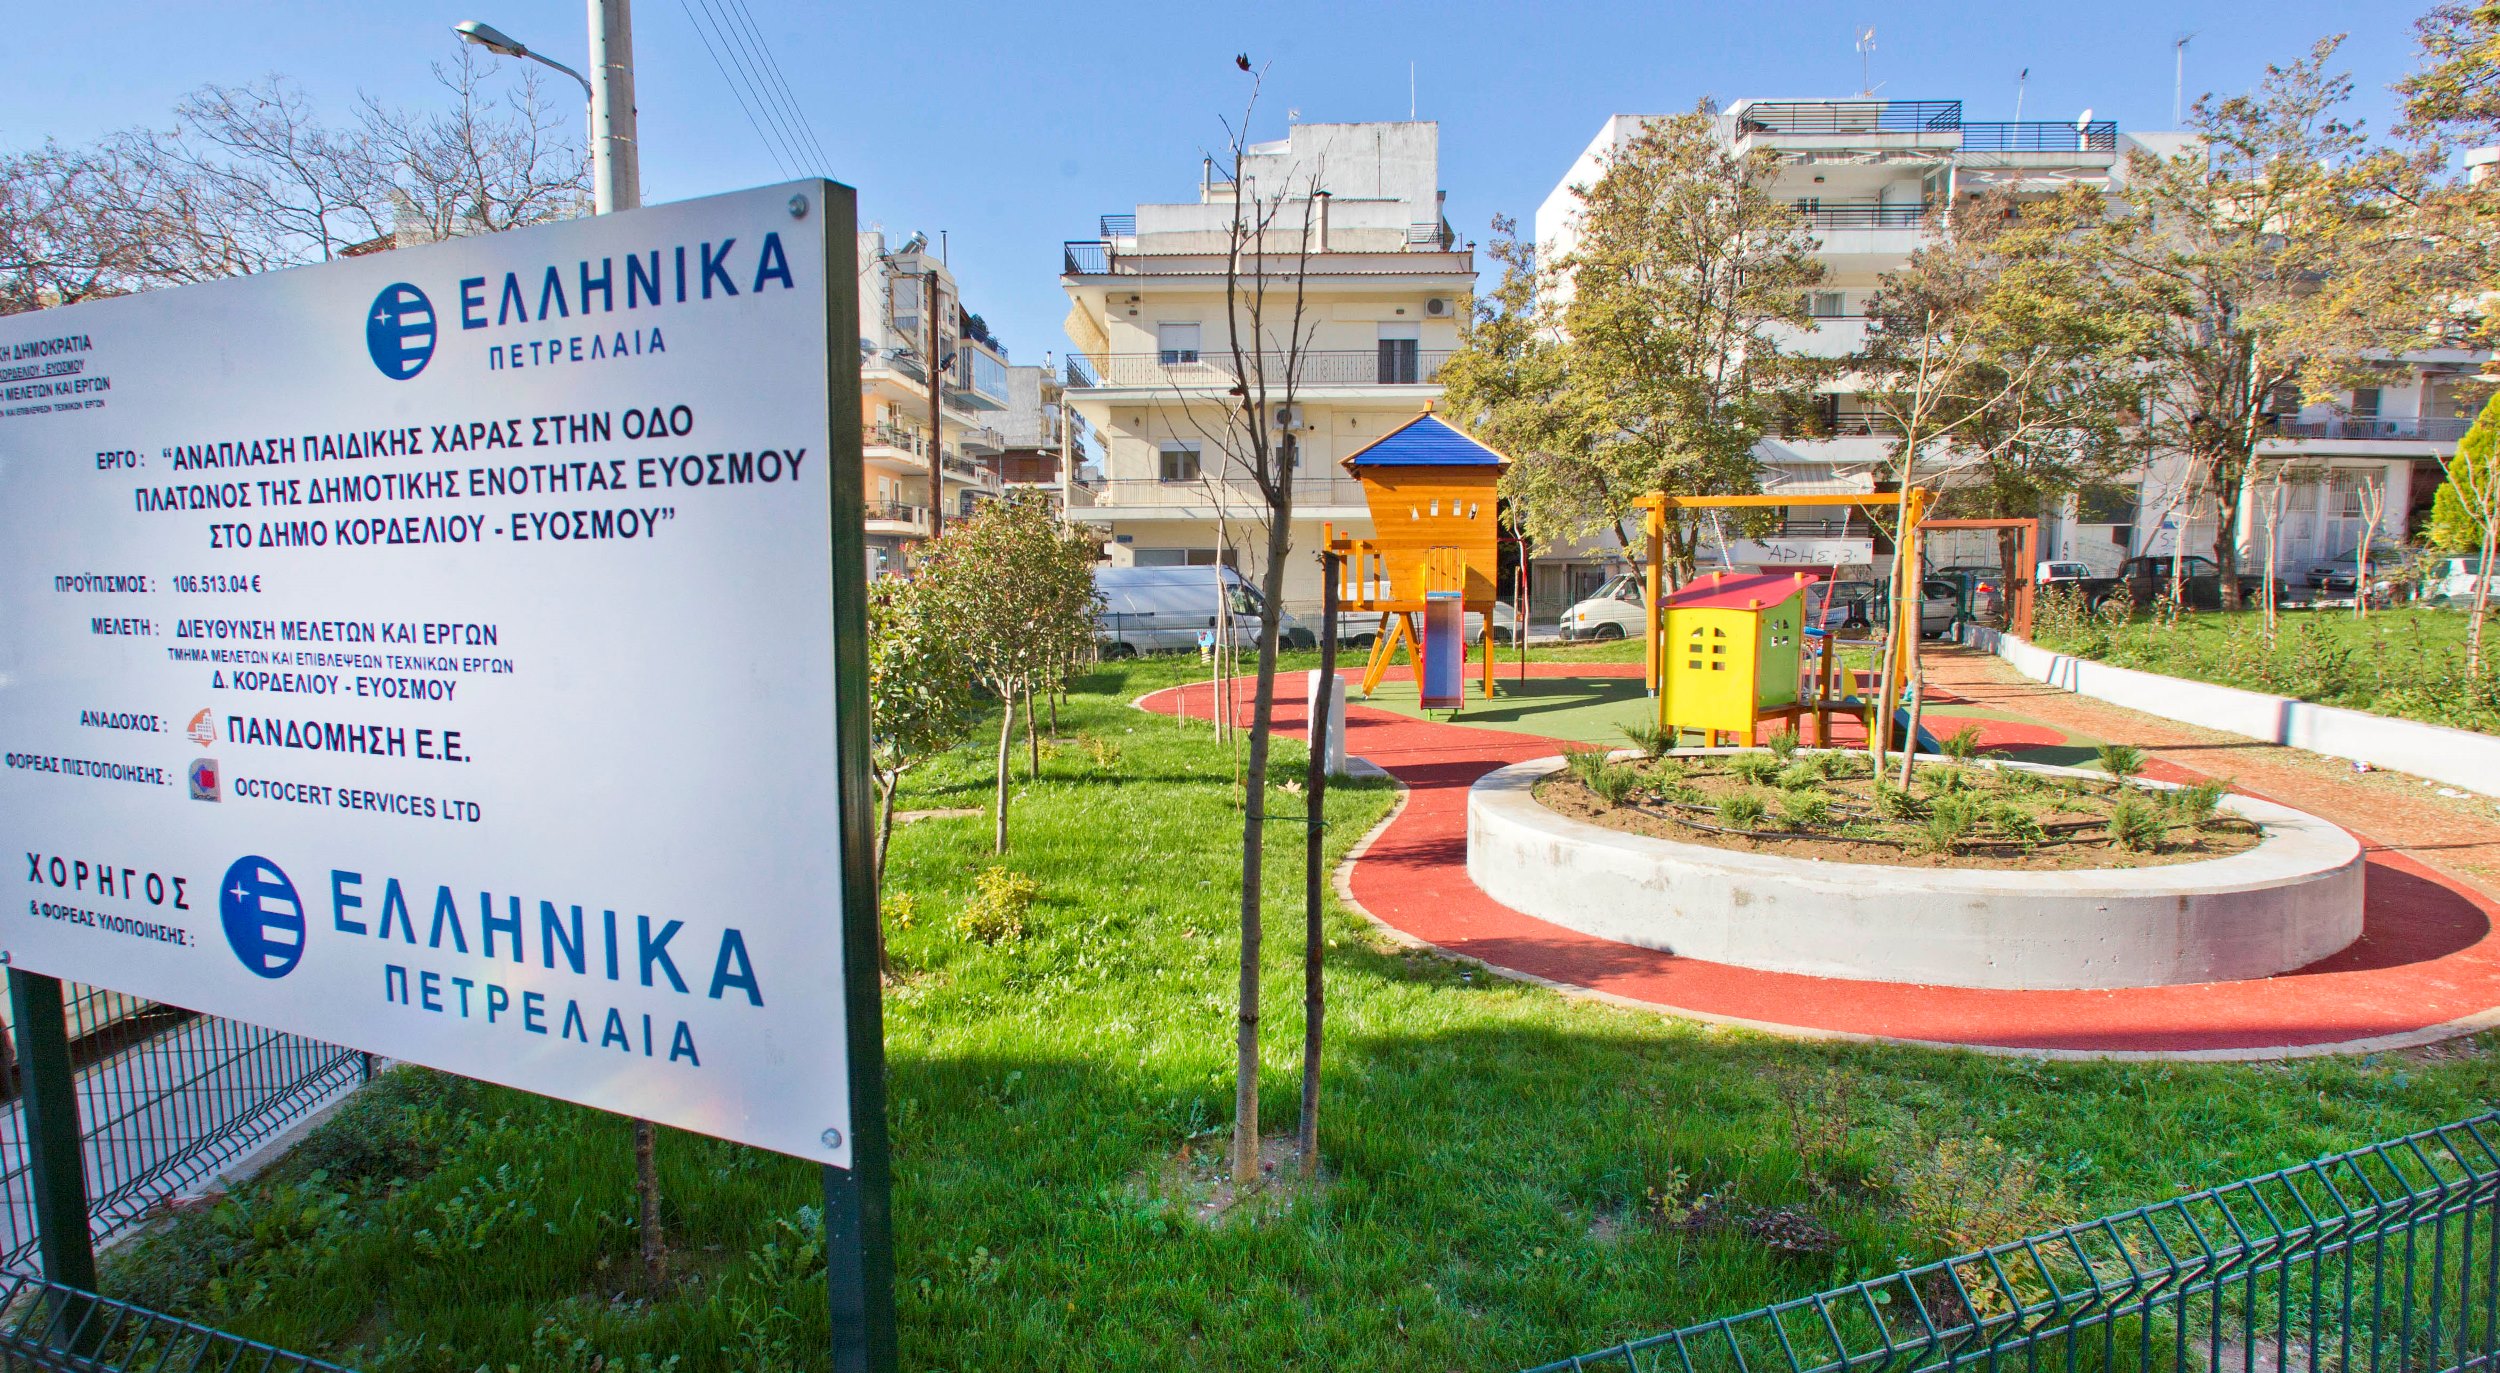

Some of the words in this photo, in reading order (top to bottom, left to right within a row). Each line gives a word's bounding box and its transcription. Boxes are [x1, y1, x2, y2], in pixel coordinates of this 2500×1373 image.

[460, 232, 794, 330] ΕΛΛΗΝΙΚΑ
[14, 335, 93, 361] ΔΗΜΟΚΡΑΤΙΑ
[490, 328, 665, 370] ΠΕΤΡΕΛΑΙΑ
[45, 359, 85, 375] ΕΥΟΣΜΟΥ
[6, 383, 53, 401] ΜΕΛΕΤΩΝ
[55, 381, 73, 396] ΚΑΙ
[75, 376, 111, 394] ΕΡΓΩΝ
[84, 399, 105, 409] ΕΡΓΩΝ
[96, 450, 136, 469] ΕΡΓΟ
[303, 428, 423, 462] ΠΑΙΔΙΚΗΣ
[431, 419, 523, 453] ΧΑΡΑΣ
[532, 411, 611, 446] ΣΤΗΝ
[622, 405, 693, 440] ΟΔΟ
[136, 482, 251, 512] ΠΛΑΤΩΝΟΣ
[257, 480, 302, 506] ΤΗΣ
[308, 470, 460, 504] ΔΗΜΟΤΙΚΗΣ
[469, 460, 627, 496] ΕΝΟΤΗΤΑΣ
[638, 448, 806, 488] ΕΥΟΣΜΟΥ
[210, 523, 252, 548] ΣΤΟ
[258, 520, 327, 547] ΔΗΜΟ
[335, 515, 485, 545] ΚΟΡΔΕΛΙΟΥ
[1768, 544, 1830, 563] ΑΡΗΣ
[92, 618, 151, 635] ΜΕΛΕΤΗ
[177, 619, 275, 640] ΔΙΕΥΘΥΝΣΗ
[281, 621, 375, 642] ΜΕΛΕΤΩΝ
[382, 623, 416, 643] ΚΑΙ
[423, 623, 497, 645] ΕΡΓΩΝ
[168, 648, 209, 661] ΤΜΗΜΑ
[211, 649, 268, 664] ΜΕΛΕΤΩΝ
[272, 652, 292, 665] ΚΑΙ
[296, 652, 382, 668] ΕΠΙΒΛΕΨΕΩΝ
[386, 655, 458, 671] ΤΕΧΝΙΚΩΝ
[463, 658, 513, 673] ΕΡΓΩΝ
[212, 670, 229, 689] Δ.
[233, 671, 338, 694] ΚΟΡΔΕΛΙΟΥ
[356, 676, 456, 701] ΕΥΟΣΜΟΥ
[81, 711, 160, 732] ΑΝΑΔΟΧΟΣ
[228, 716, 405, 757] ΠΑΝΔΟΜΗΣΗ
[416, 729, 470, 762] Ε.Ε.
[6, 753, 59, 773] ΦΟΡΕΑΣ
[62, 758, 164, 785] ΠΙΣΤΟΠΟΙΗΣΗΣ
[235, 778, 332, 805] OCTOCERT
[338, 788, 436, 817] SERVICES
[443, 800, 480, 822] LTD
[27, 852, 189, 910] ΧΟΡΗΓΟΣ
[30, 900, 39, 915] &
[41, 903, 95, 927] ΦΟΡΕΑΣ
[331, 870, 764, 1007] ΕΛΛΗΝΙΚΑ
[385, 964, 700, 1067] ΠΕΤΡΕΛΑΙΑ
